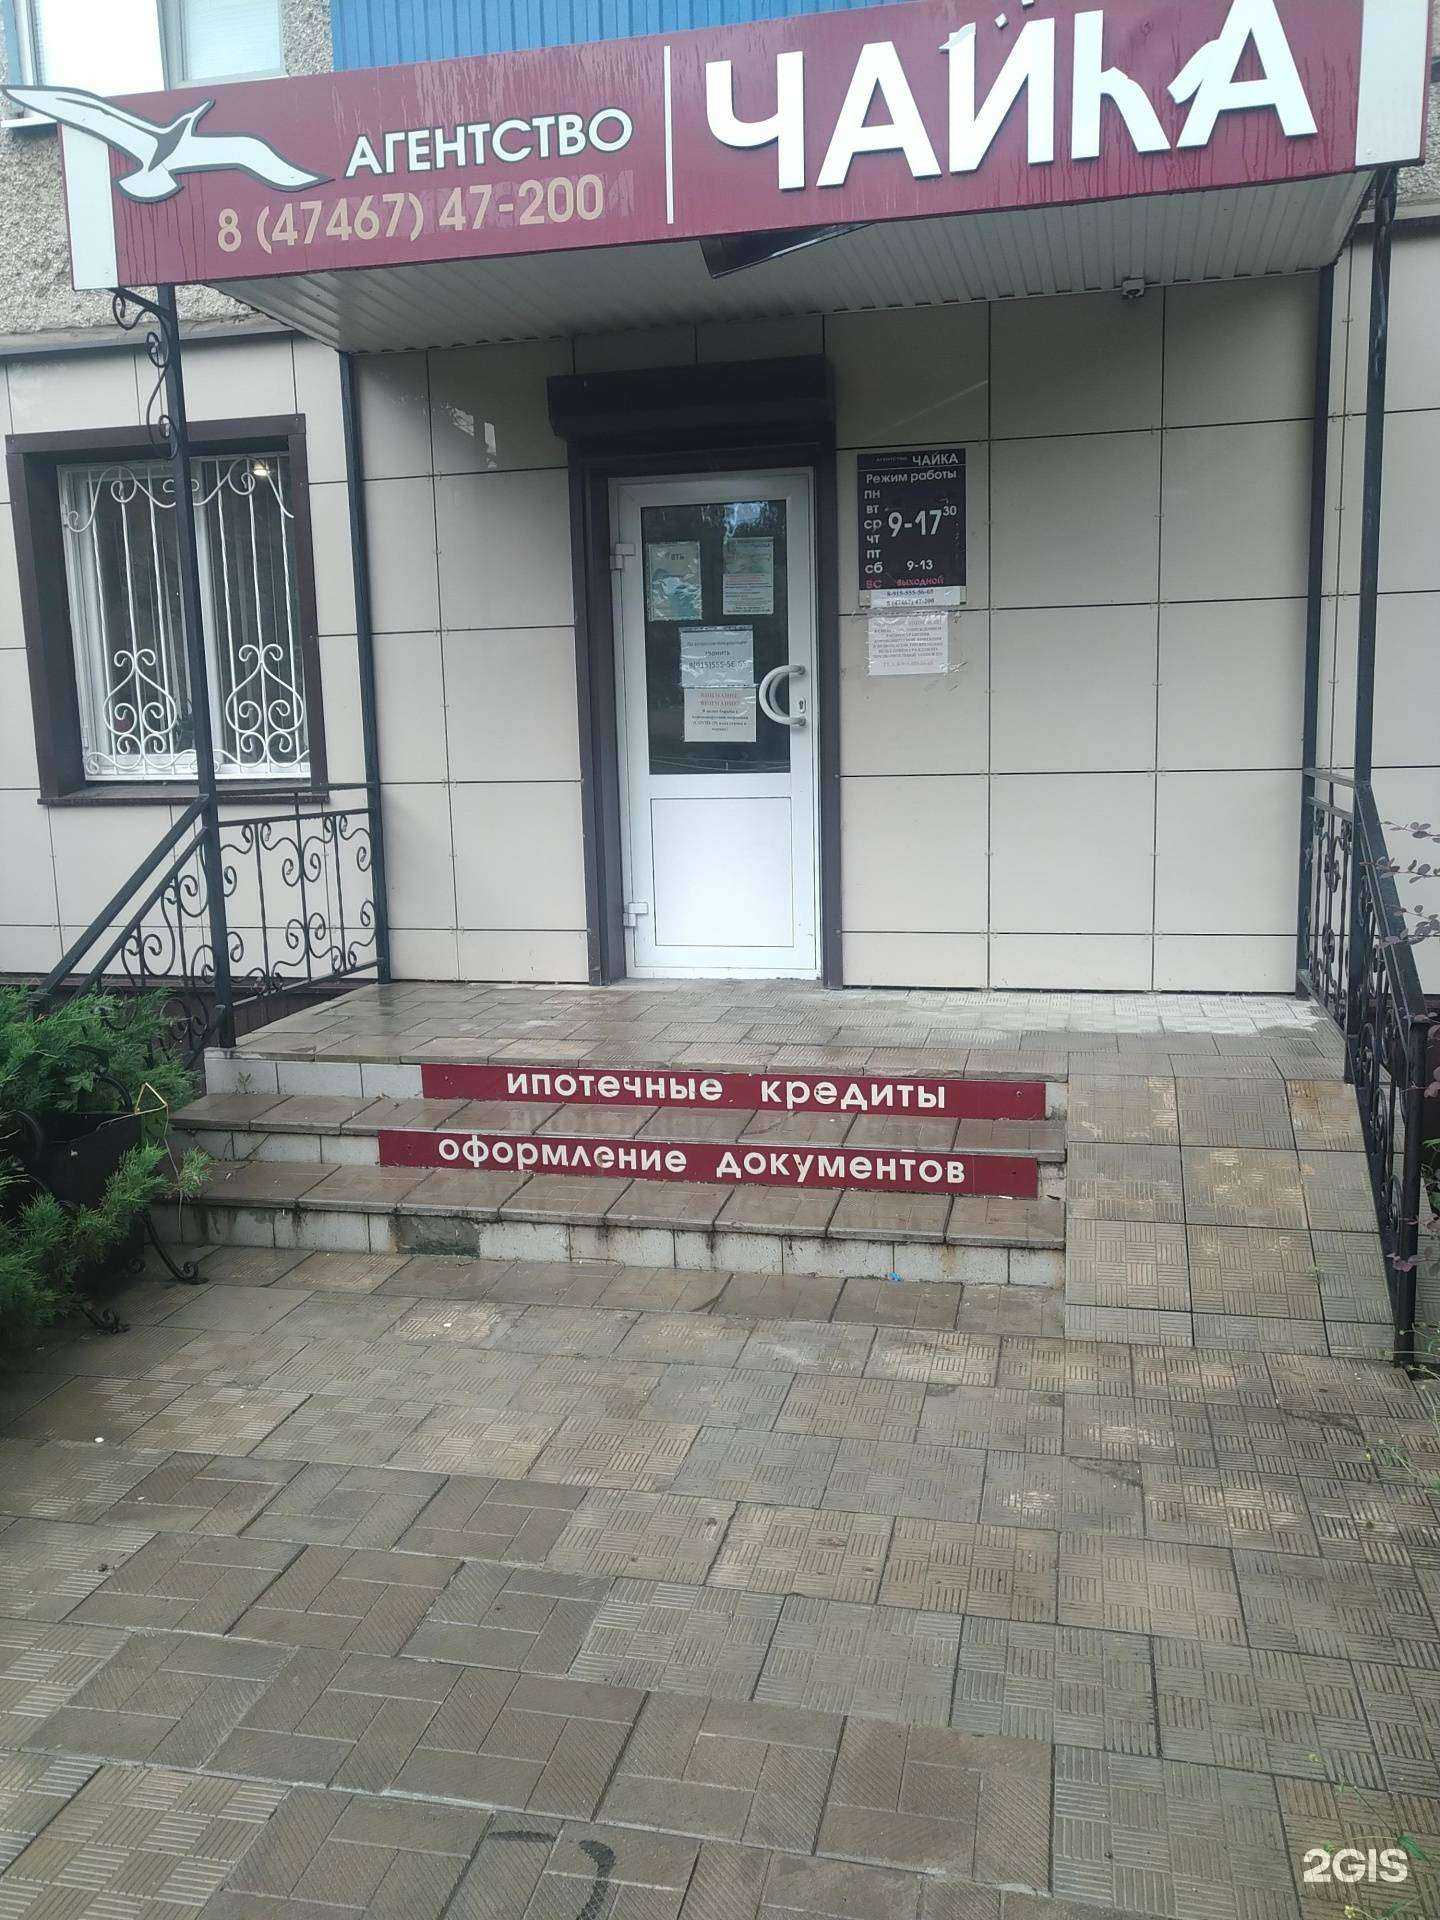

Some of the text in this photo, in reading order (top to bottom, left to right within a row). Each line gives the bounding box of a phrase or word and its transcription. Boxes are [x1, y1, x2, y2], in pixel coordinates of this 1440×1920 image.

[705, 0, 1318, 192] ЧАЙКА
[344, 107, 633, 179] АГЕНТСТВО
[217, 207, 241, 252] 8
[257, 191, 424, 255] (47467)
[438, 174, 604, 231] 47-200
[912, 452, 959, 465] ЧАЙКА
[866, 469, 957, 484] Режим работы
[863, 519, 882, 531] ср
[888, 509, 942, 537] 9-17
[864, 561, 883, 574] сб
[906, 560, 933, 571] 9-13
[506, 1070, 946, 1111] ипотечные кредиты
[438, 1132, 966, 1184] оформление документов
